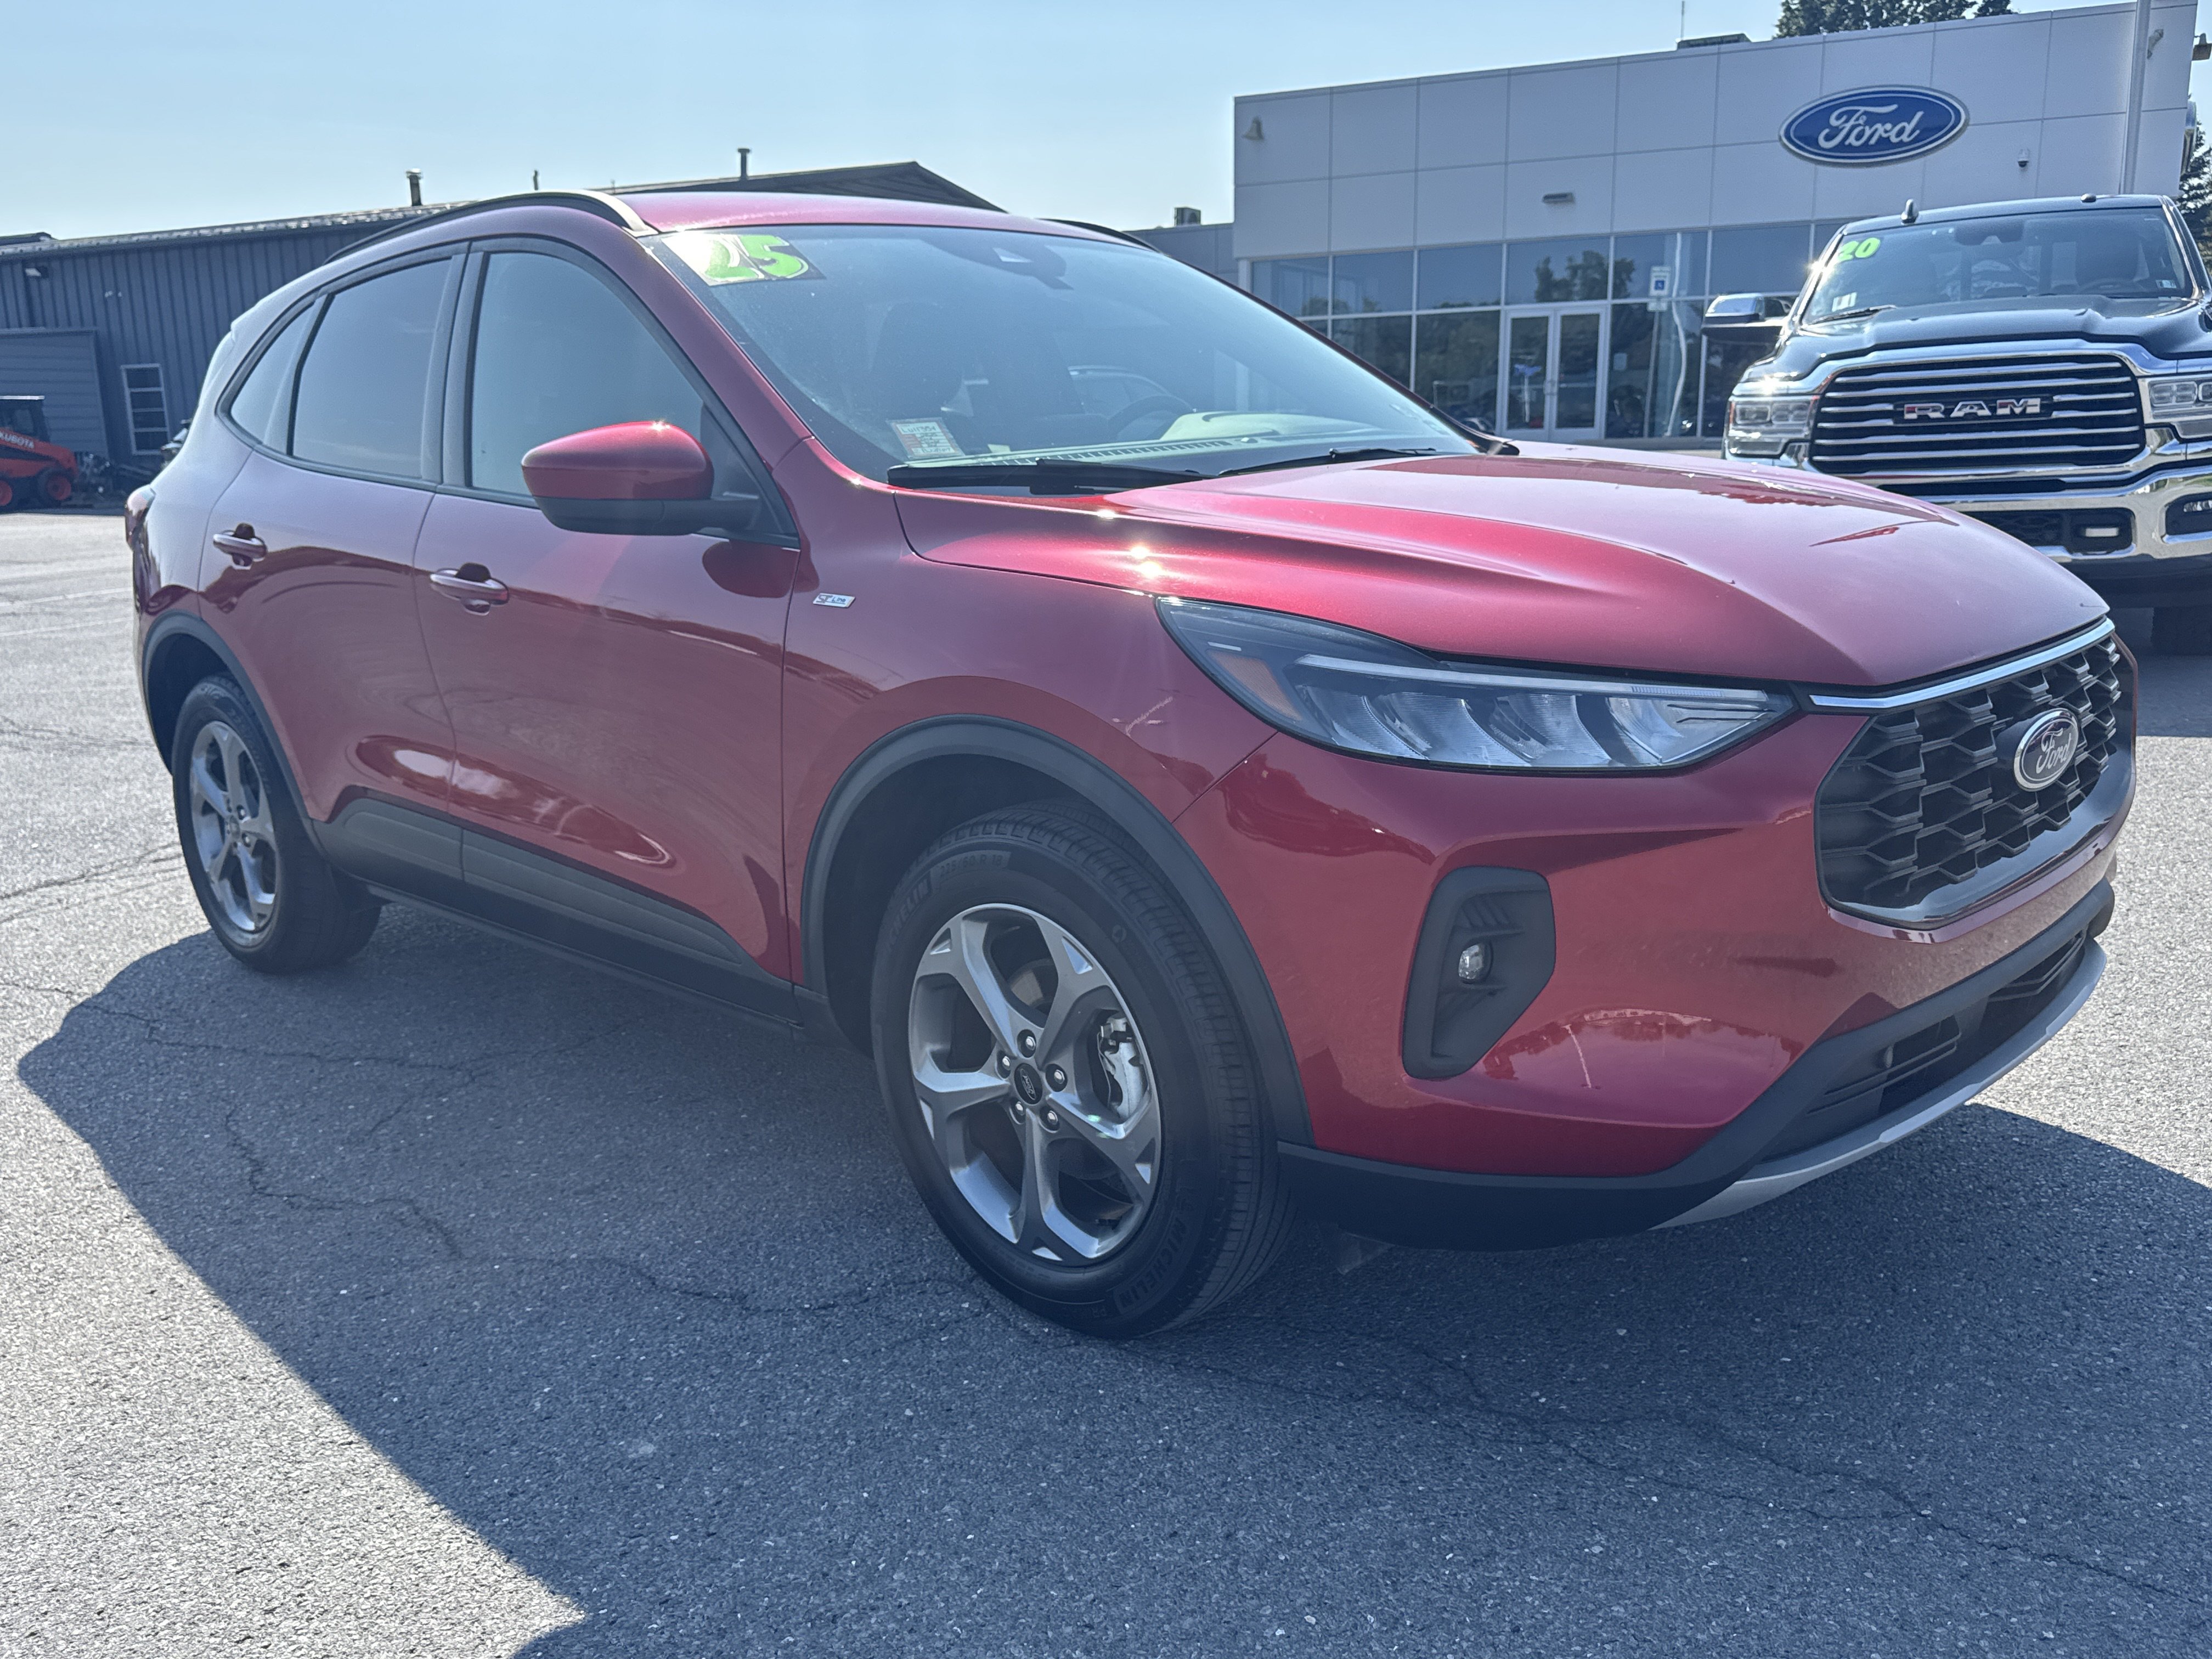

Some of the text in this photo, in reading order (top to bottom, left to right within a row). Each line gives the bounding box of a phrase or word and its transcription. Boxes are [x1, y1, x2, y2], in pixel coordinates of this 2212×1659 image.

[1818, 104, 1925, 149] Ford
[701, 233, 810, 282] 25
[1837, 237, 1881, 262] 20
[1904, 398, 2041, 420] RAM
[816, 594, 833, 604] ST
[2036, 727, 2072, 774] Ford
[991, 854, 1003, 867] 18
[1118, 1216, 1188, 1308] MICHELIN
